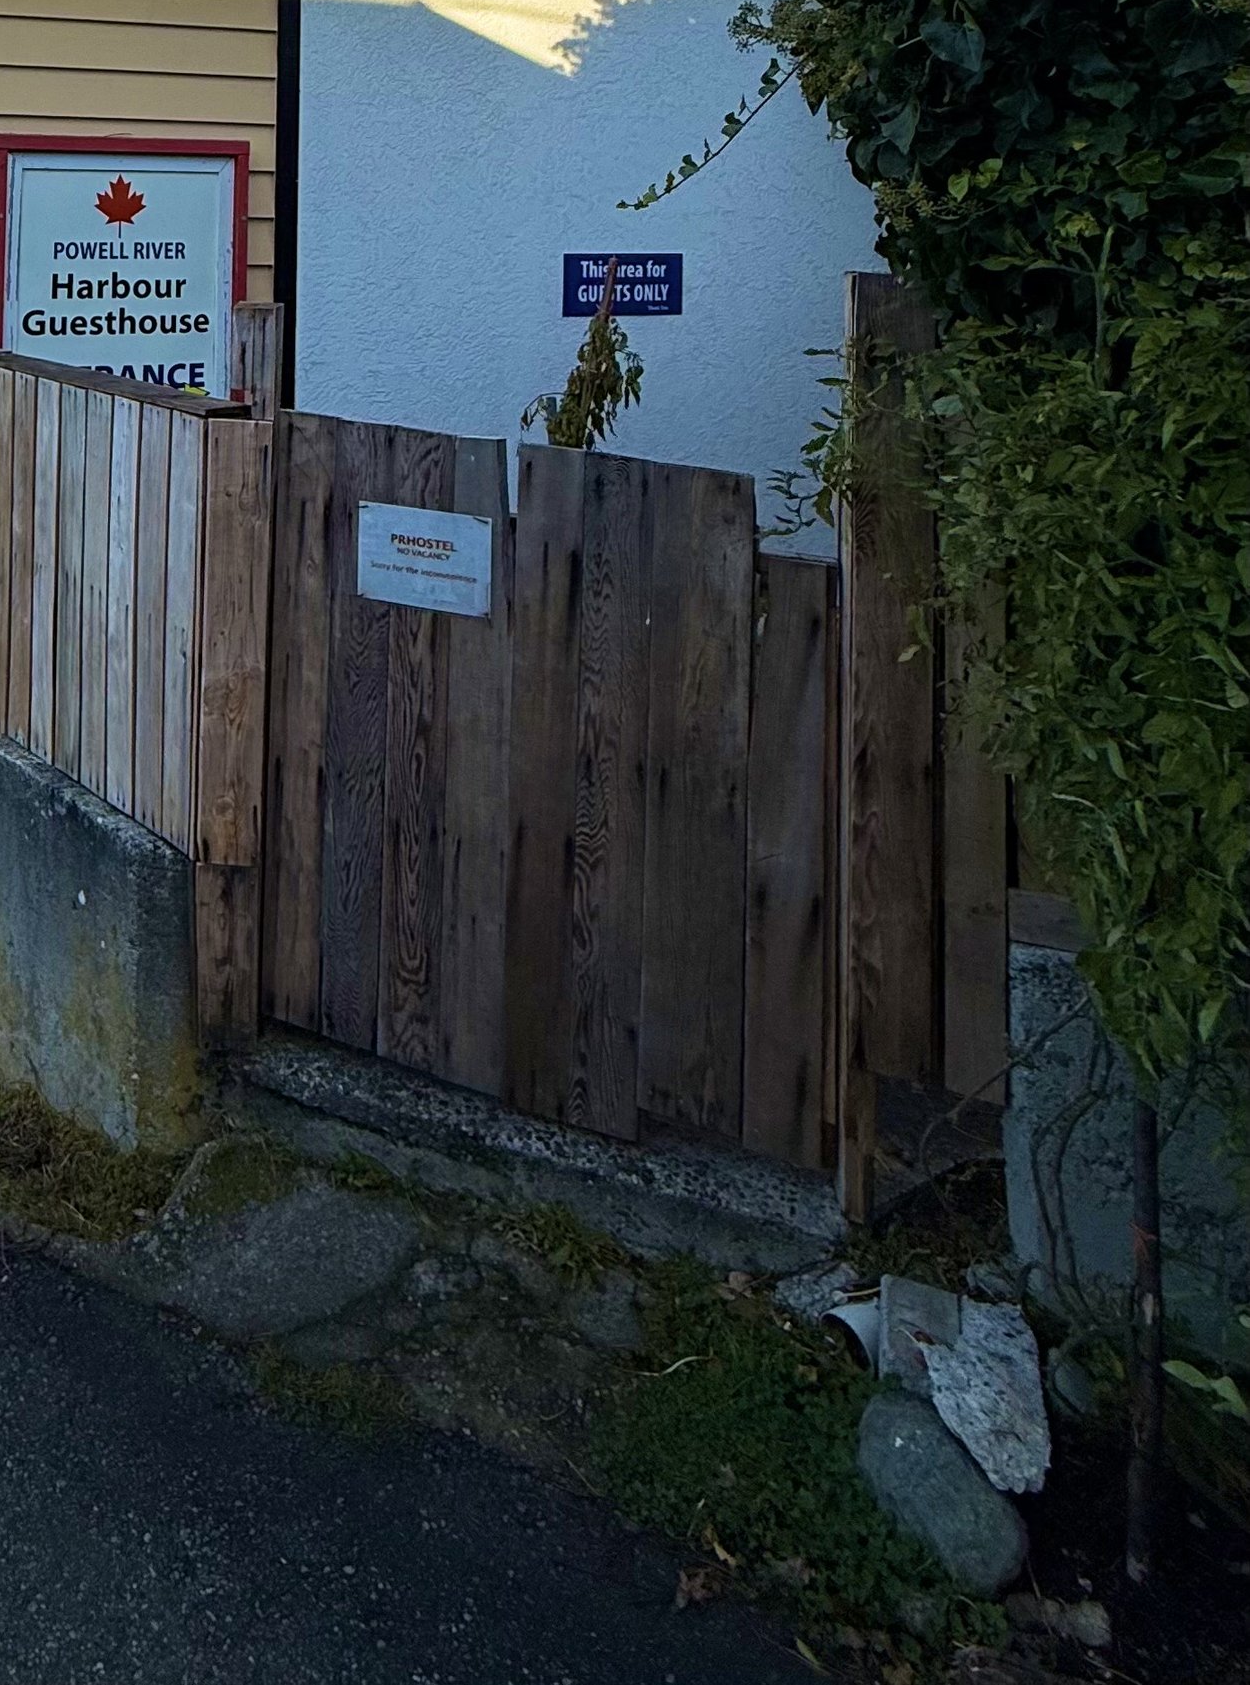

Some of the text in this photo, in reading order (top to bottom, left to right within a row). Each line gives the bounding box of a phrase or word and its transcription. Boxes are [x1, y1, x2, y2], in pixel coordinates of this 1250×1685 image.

[53, 241, 186, 260] POWELL RIVER
[646, 260, 667, 278] for
[51, 271, 187, 300] Harbour
[578, 284, 670, 302] GUETS ONLY
[22, 307, 210, 336] Guesthouse
[391, 533, 458, 552] PRHOSTEL
[397, 547, 451, 561] NO VACANCY
